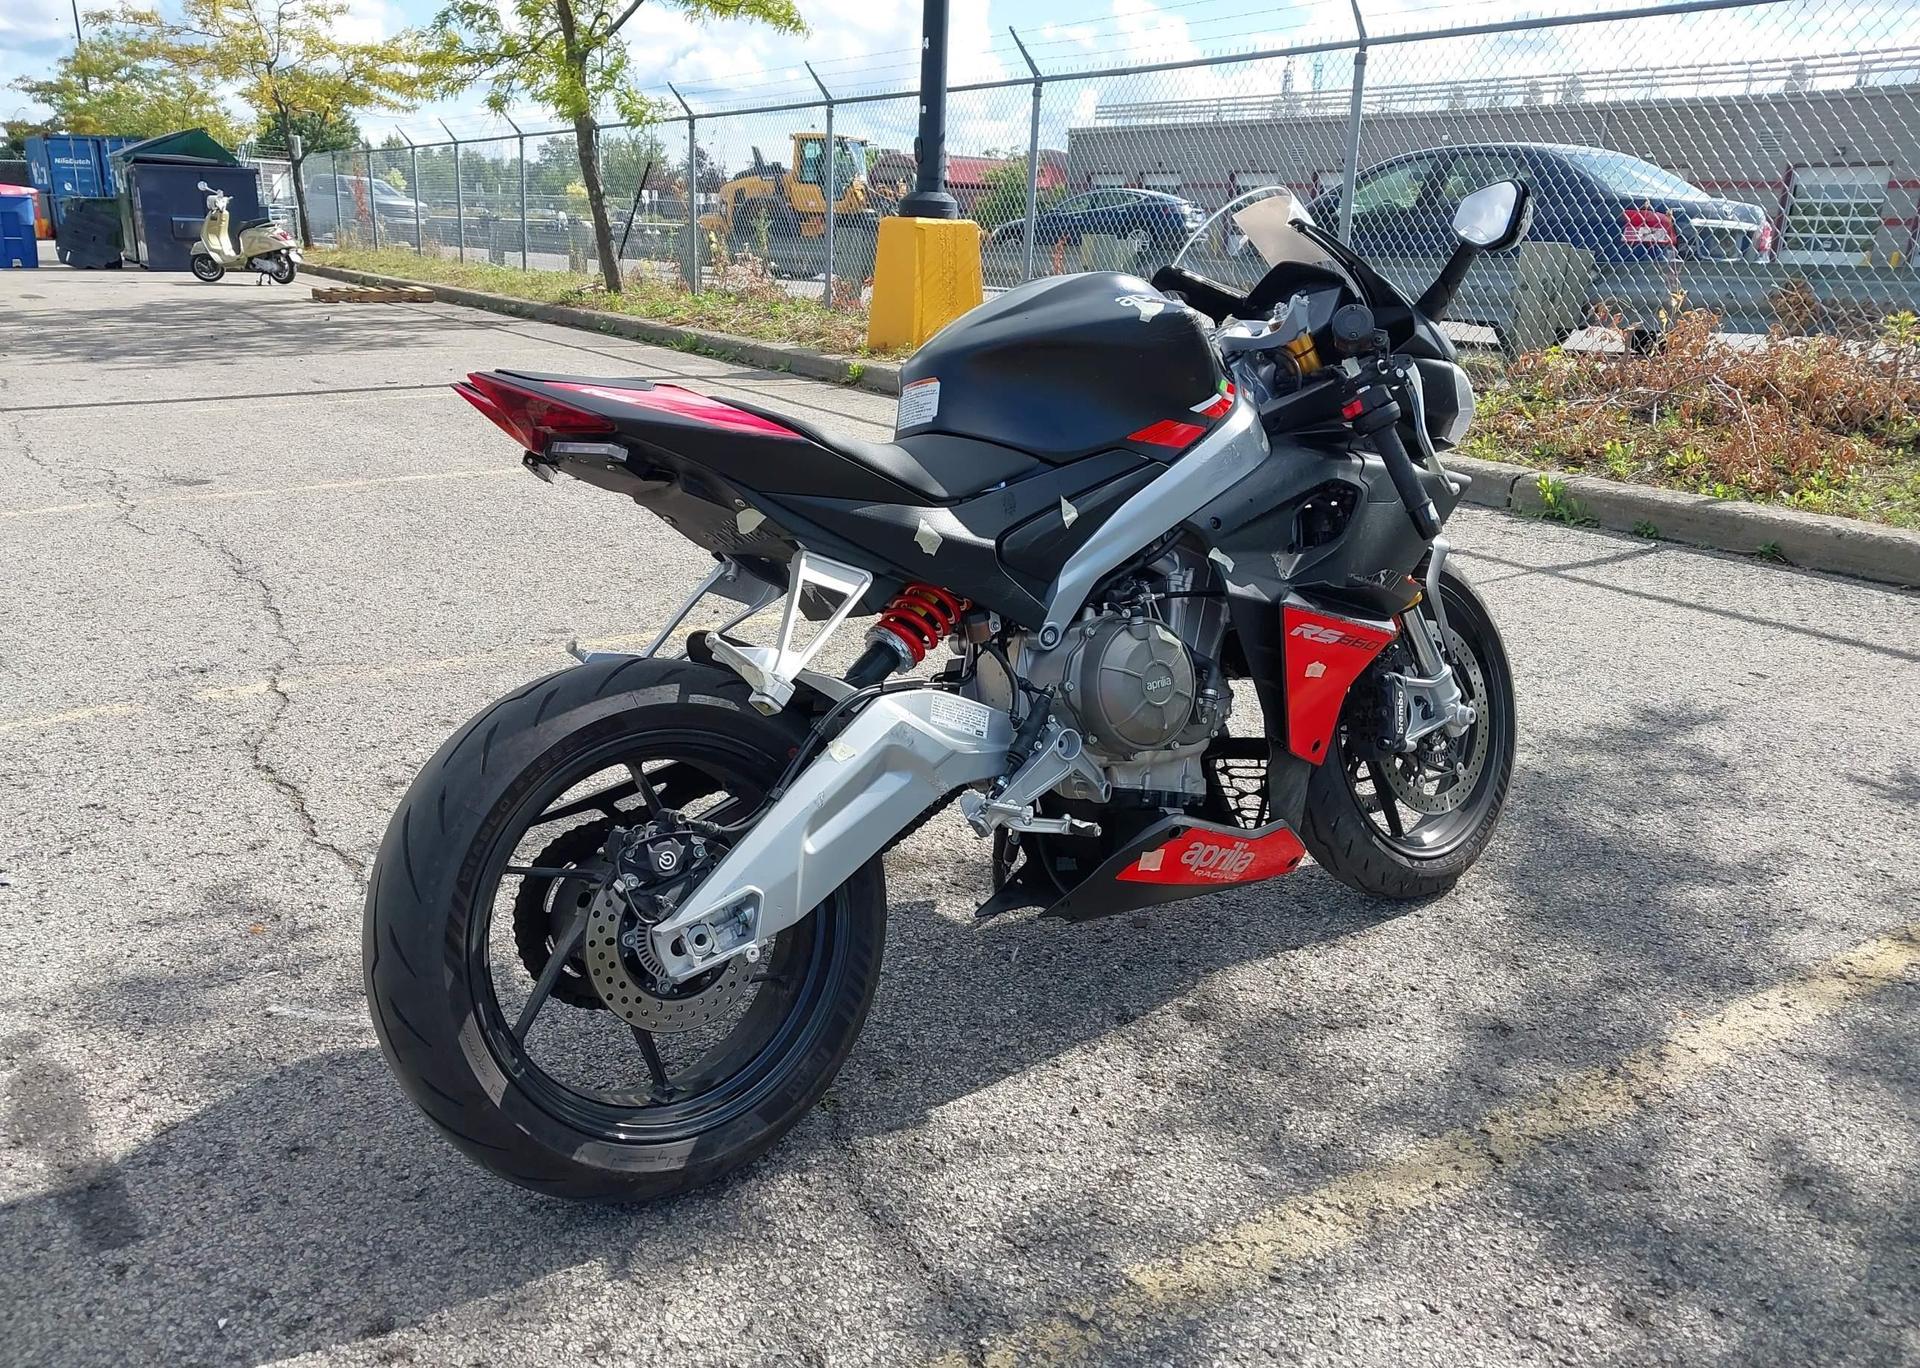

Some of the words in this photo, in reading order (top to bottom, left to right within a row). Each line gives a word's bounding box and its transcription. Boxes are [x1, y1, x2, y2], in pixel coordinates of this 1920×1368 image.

[1146, 675, 1172, 692] aprilia
[1181, 841, 1256, 872] aprilia
[1193, 869, 1240, 880] RACING
